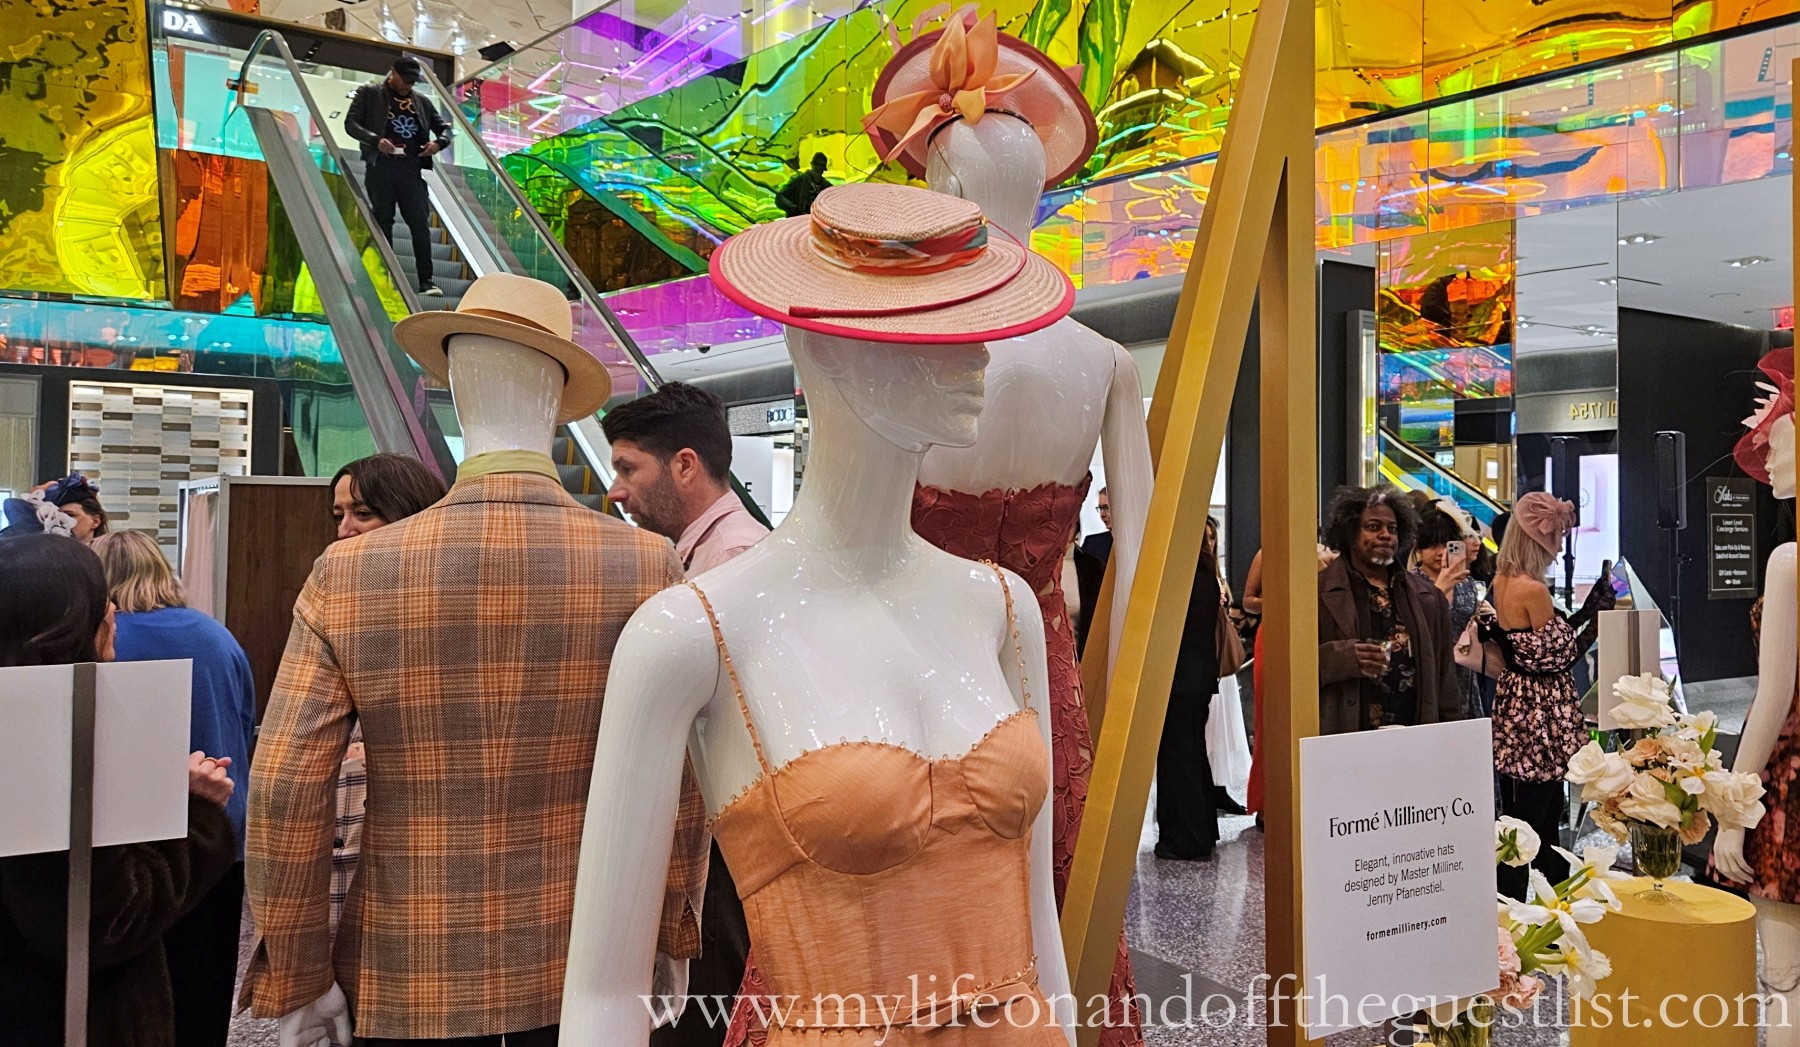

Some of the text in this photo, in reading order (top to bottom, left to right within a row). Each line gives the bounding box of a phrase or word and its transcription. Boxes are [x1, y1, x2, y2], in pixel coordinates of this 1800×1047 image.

[1329, 797, 1475, 838] Formé Millinery Co.
[1354, 843, 1455, 872] Elegant, innovative hats
[1344, 860, 1464, 893] designed by Master Milliner,
[1366, 880, 1445, 907] Jenny Pfanenstiel.
[1366, 916, 1447, 941] formemillinery.com
